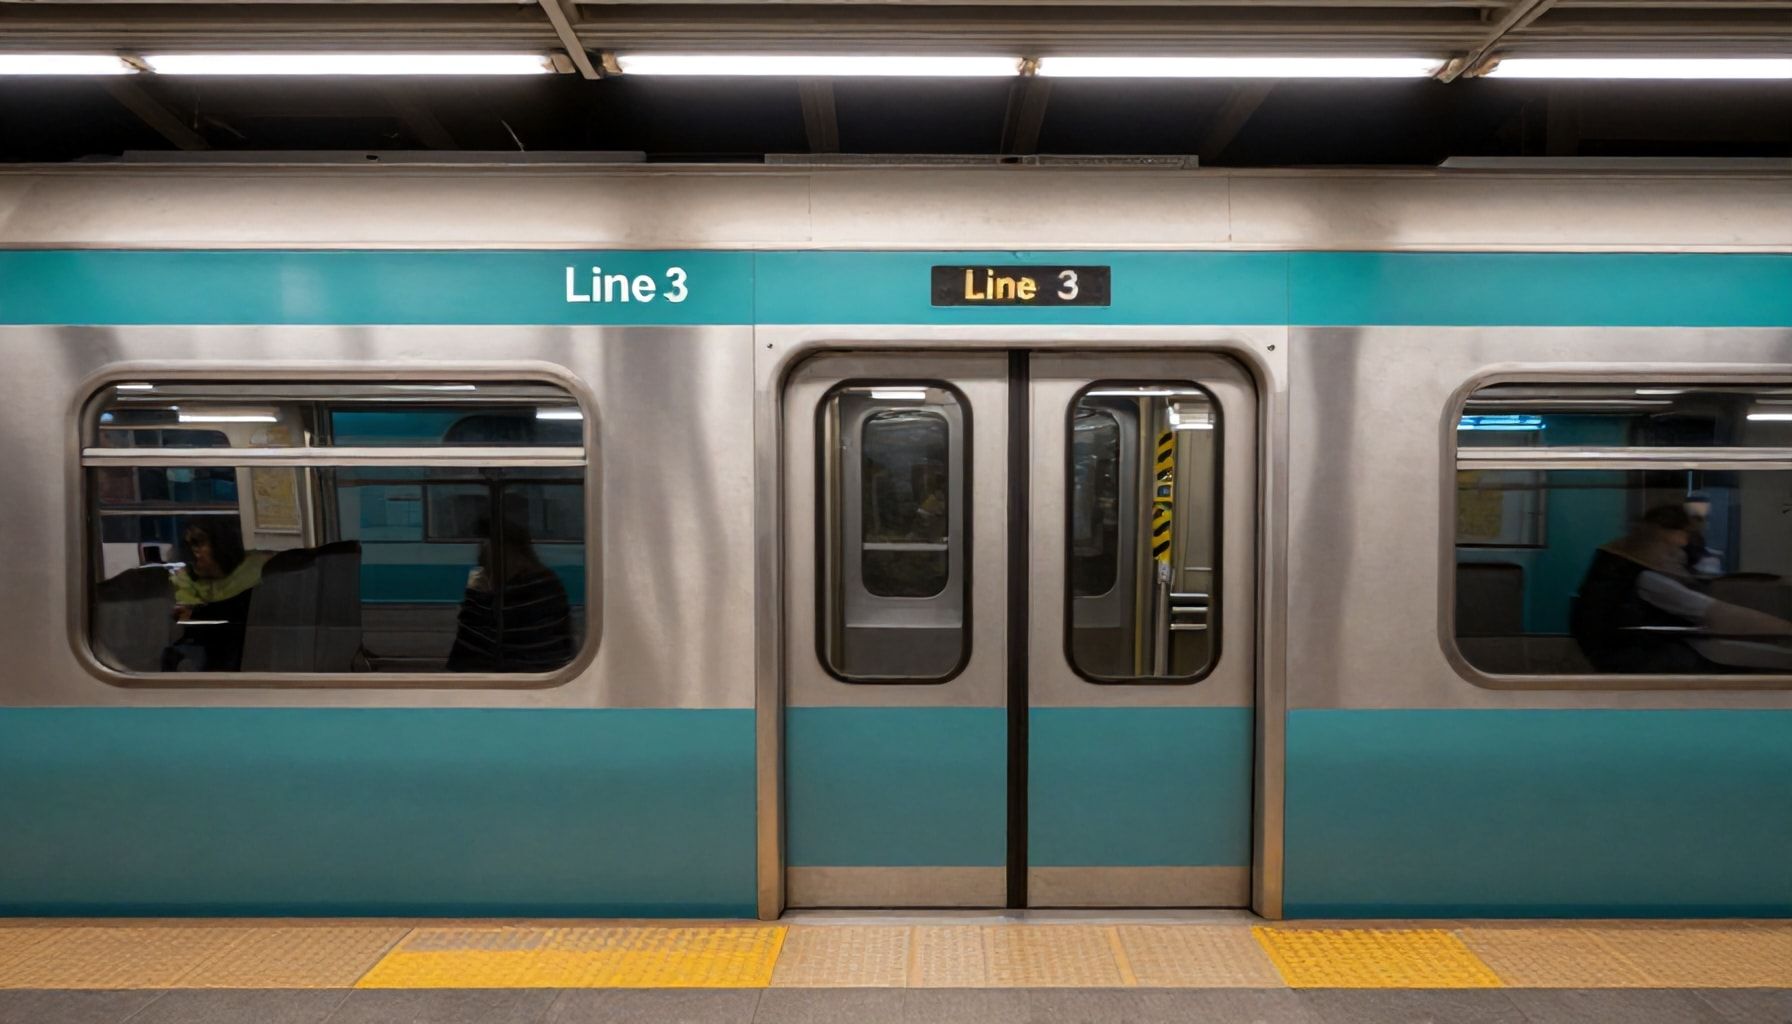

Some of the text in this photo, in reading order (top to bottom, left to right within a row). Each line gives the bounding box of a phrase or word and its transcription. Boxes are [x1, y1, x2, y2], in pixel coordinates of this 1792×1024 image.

[566, 266, 689, 303] Line 3
[964, 269, 1079, 301] Line 3
